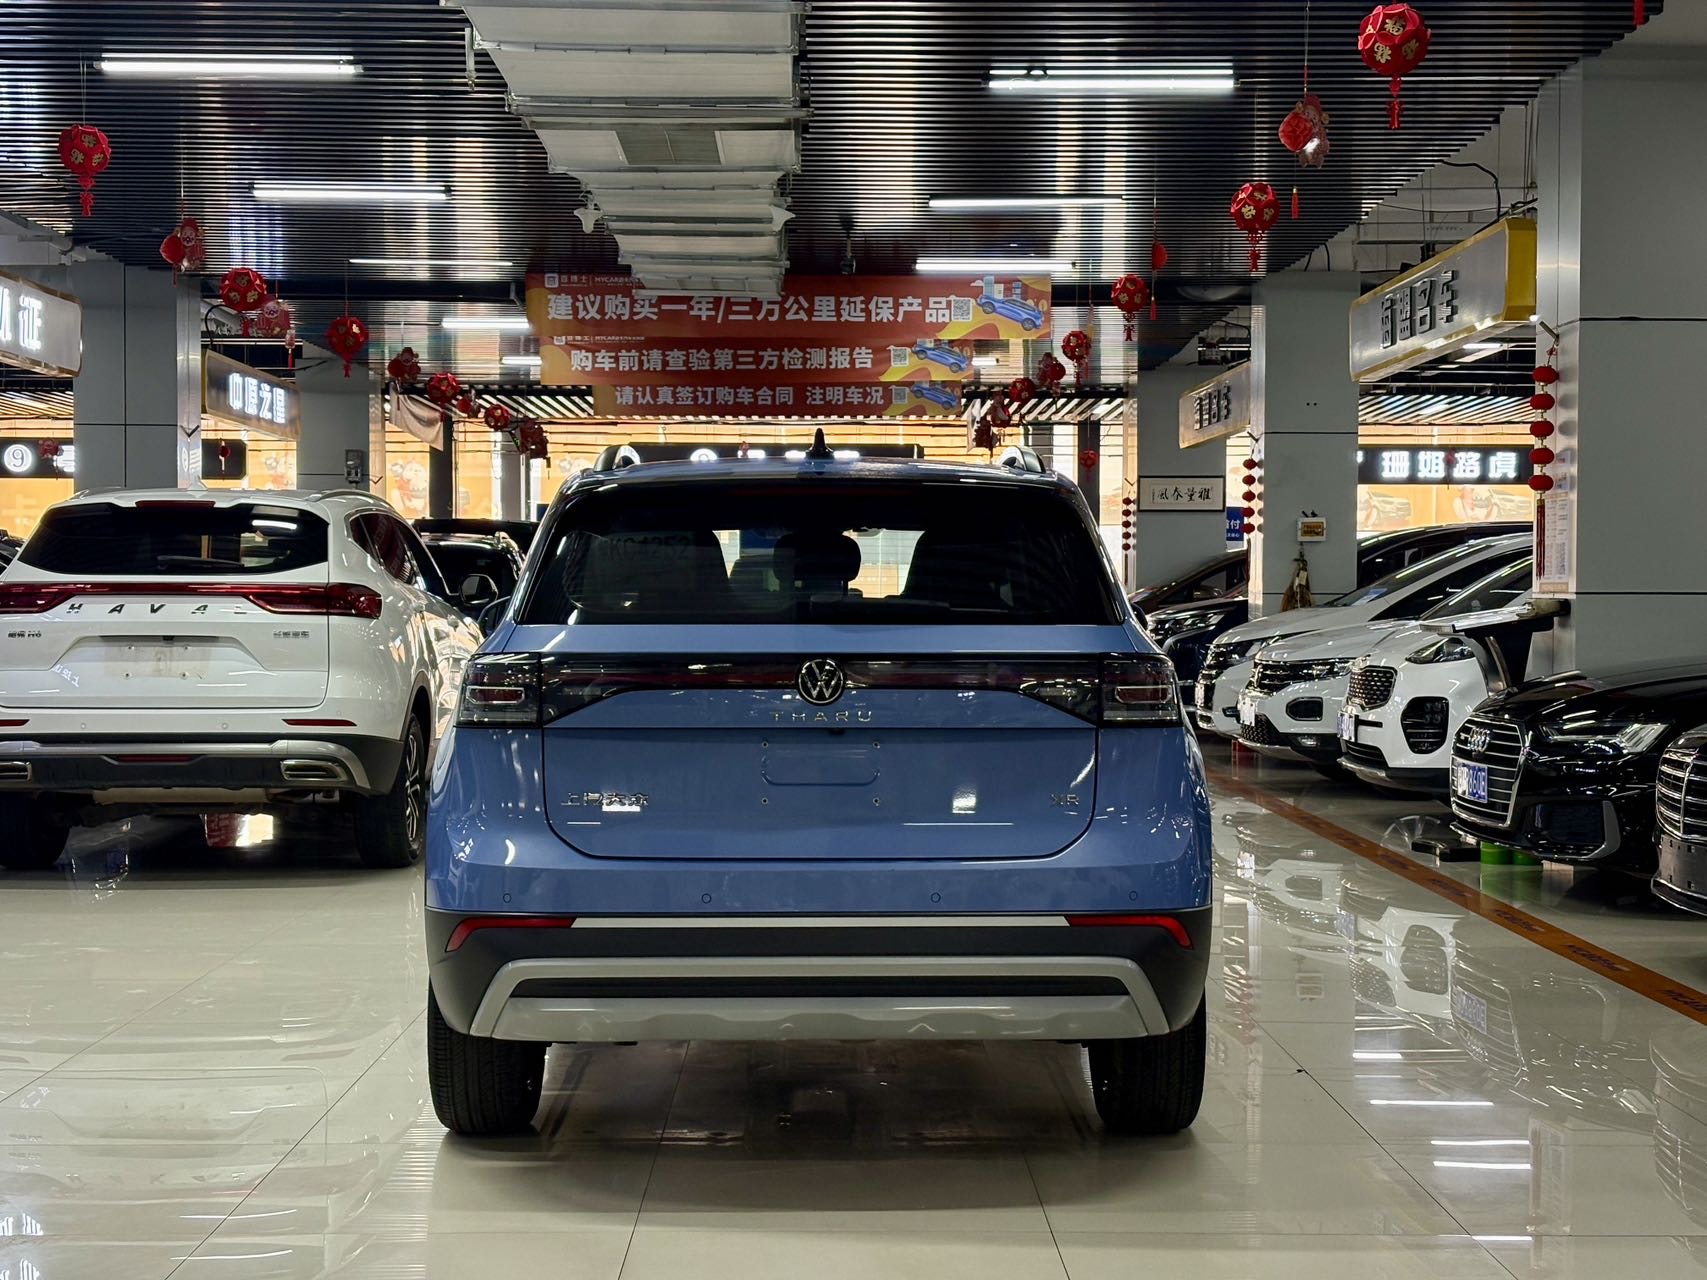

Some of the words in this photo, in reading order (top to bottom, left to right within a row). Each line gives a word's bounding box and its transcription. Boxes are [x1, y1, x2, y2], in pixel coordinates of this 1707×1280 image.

[547, 294, 951, 323] 建议购买一年/三万公里延保产品
[571, 347, 873, 371] 购车前请查验第三方检测报告
[615, 386, 794, 405] 请认真签订购车合同
[806, 386, 885, 405] 注明车况
[1382, 451, 1517, 478] 珊姐路虎
[769, 711, 872, 722] THARU
